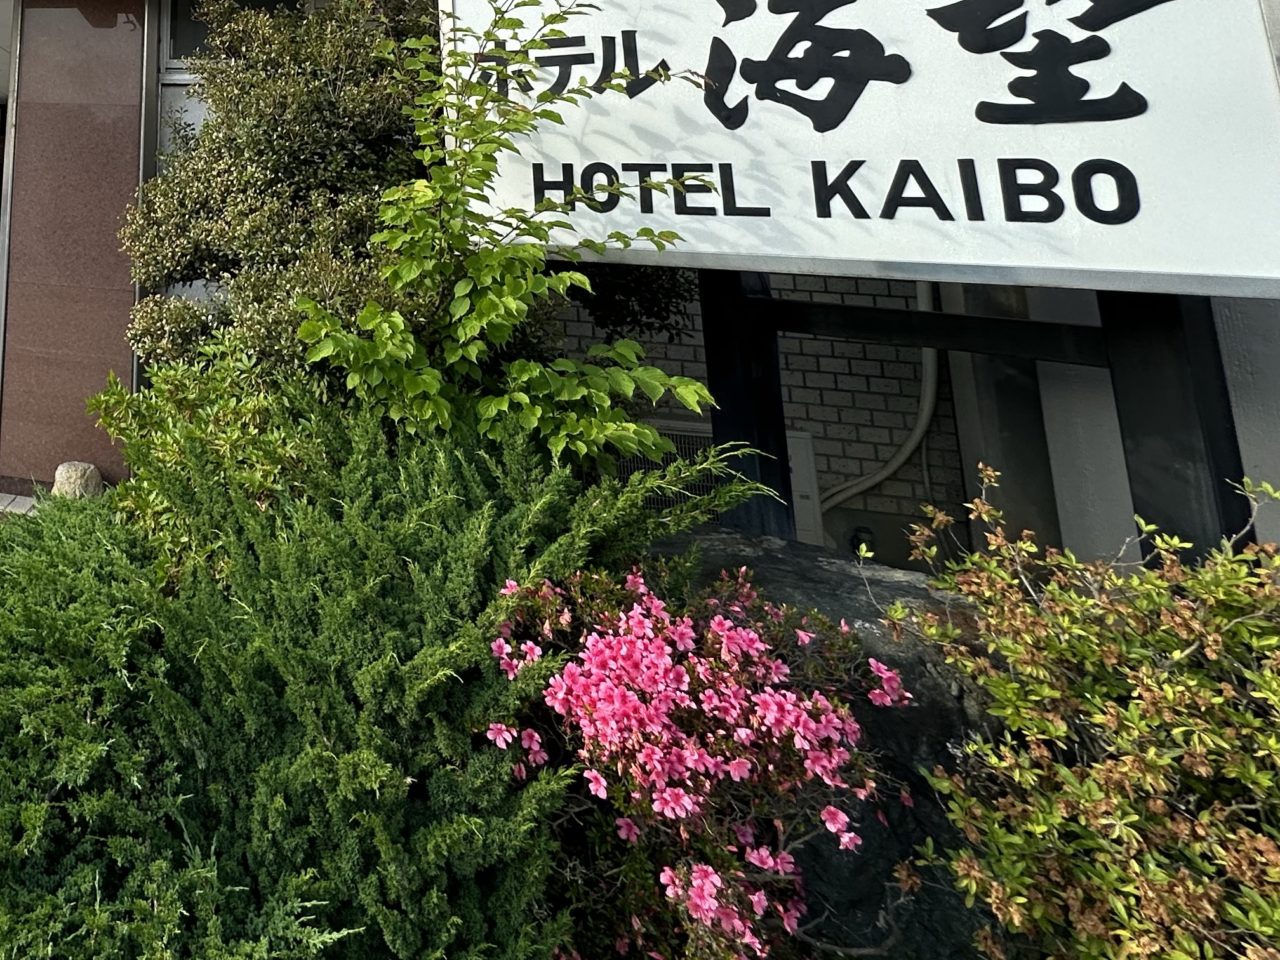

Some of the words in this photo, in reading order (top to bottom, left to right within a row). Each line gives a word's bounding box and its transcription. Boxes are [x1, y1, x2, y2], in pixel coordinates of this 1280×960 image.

[474, 29, 671, 100] ホテル
[531, 161, 771, 218] HOTEL
[811, 157, 1141, 225] KAIBO
